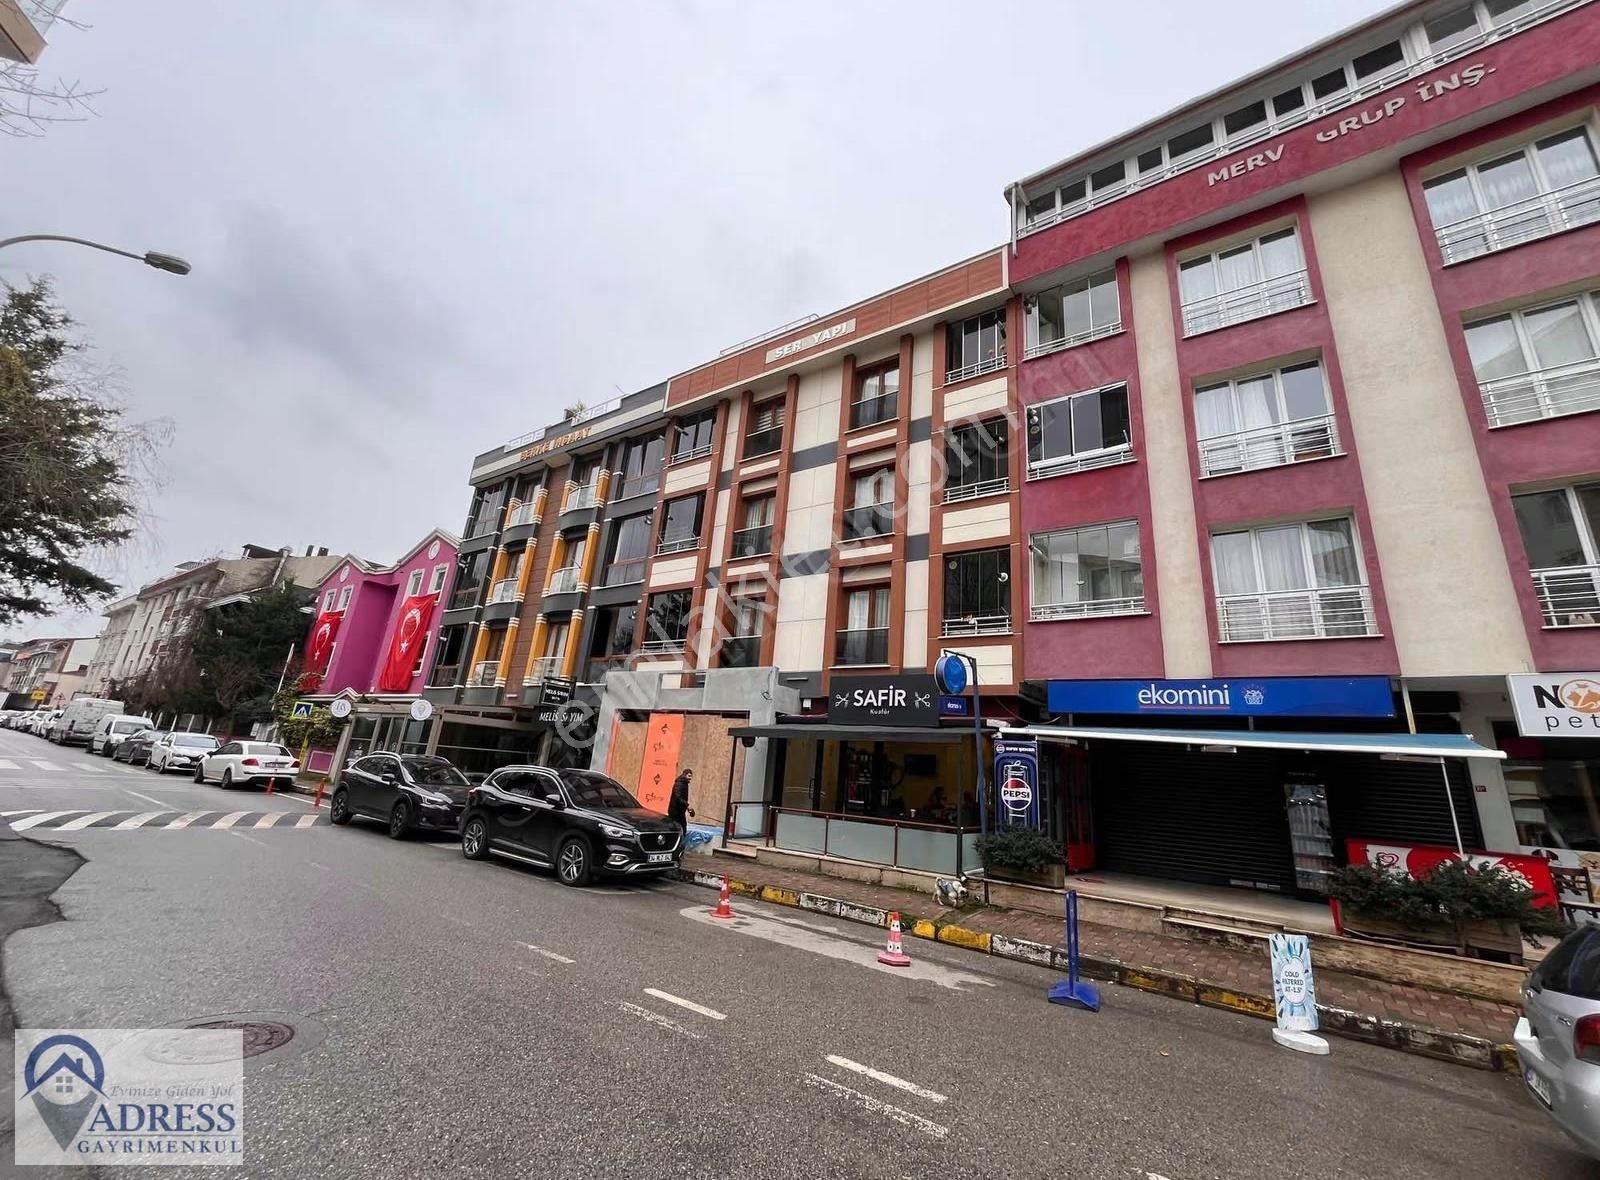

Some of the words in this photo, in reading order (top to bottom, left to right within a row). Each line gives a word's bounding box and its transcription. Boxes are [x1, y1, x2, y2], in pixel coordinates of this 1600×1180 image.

[1208, 144, 1285, 187] MERV
[1316, 97, 1406, 143] GRUP
[1415, 63, 1497, 102] İNŞ.
[813, 323, 848, 344] YAPI
[853, 685, 907, 707] SAFİR
[1138, 684, 1230, 705] ekomini
[1003, 790, 1030, 799] PEPSI
